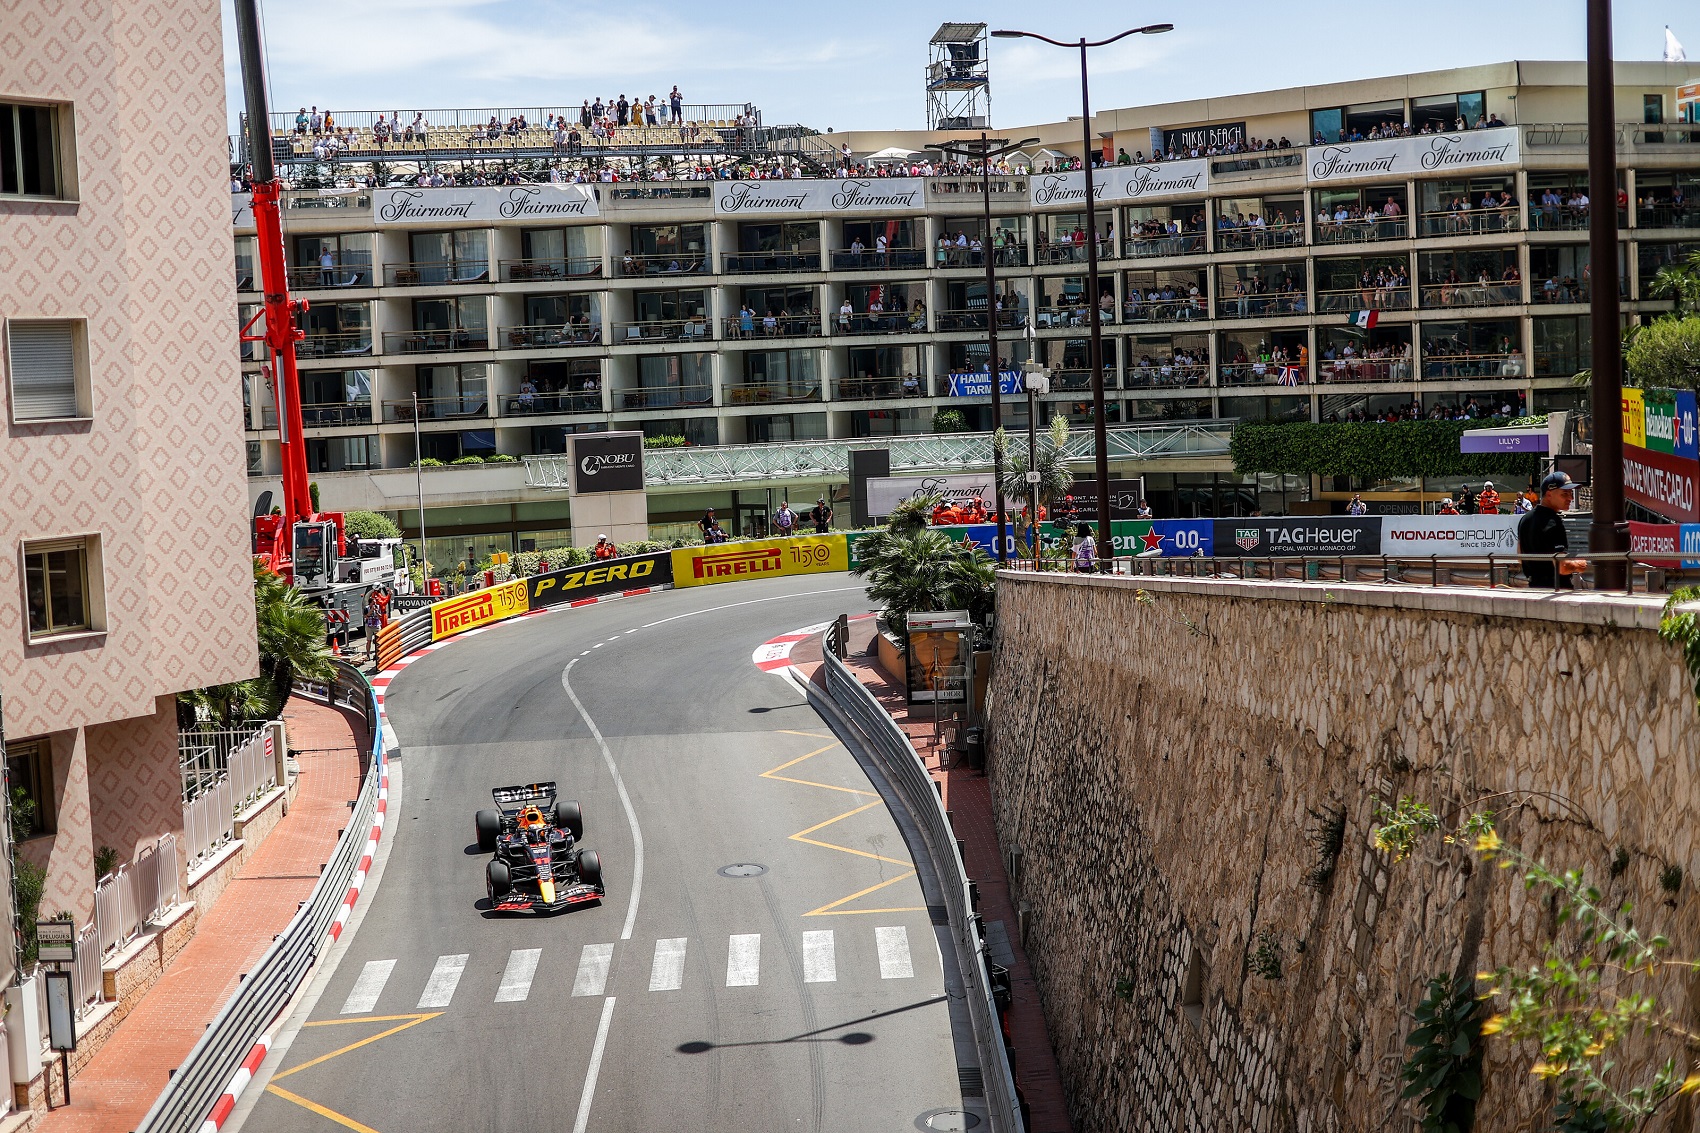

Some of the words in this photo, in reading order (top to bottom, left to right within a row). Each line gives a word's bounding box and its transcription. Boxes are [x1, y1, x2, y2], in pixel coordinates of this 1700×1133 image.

[1181, 130, 1206, 149] NIKKI
[1209, 126, 1242, 147] BEACH
[1313, 146, 1399, 179] Fairmont
[1421, 136, 1513, 170] Fairmont
[831, 180, 919, 210] Fairmont
[1126, 165, 1203, 197] Fairmont
[380, 190, 477, 222] Fairmont
[499, 187, 592, 219] Fairmont
[720, 182, 810, 212] Fairmont
[959, 372, 1011, 384] HAMILON
[964, 384, 1007, 395] TARMC
[1645, 406, 1673, 440] Heineken
[1498, 437, 1521, 445] LILLY'S
[594, 453, 635, 464] NOBU
[1643, 465, 1693, 512] MONTE-CARLO
[1378, 504, 1419, 514] OPENING
[1175, 529, 1199, 549] 0.0
[1237, 538, 1258, 549] HEUER
[1656, 537, 1675, 553] PARIS
[692, 547, 782, 579] PIRELLI
[790, 544, 830, 568] 150
[534, 577, 556, 598] P
[561, 560, 655, 591] ZERO
[397, 599, 433, 607] PIOVANO
[435, 592, 494, 635] PIRELLI
[497, 582, 528, 611] 150
